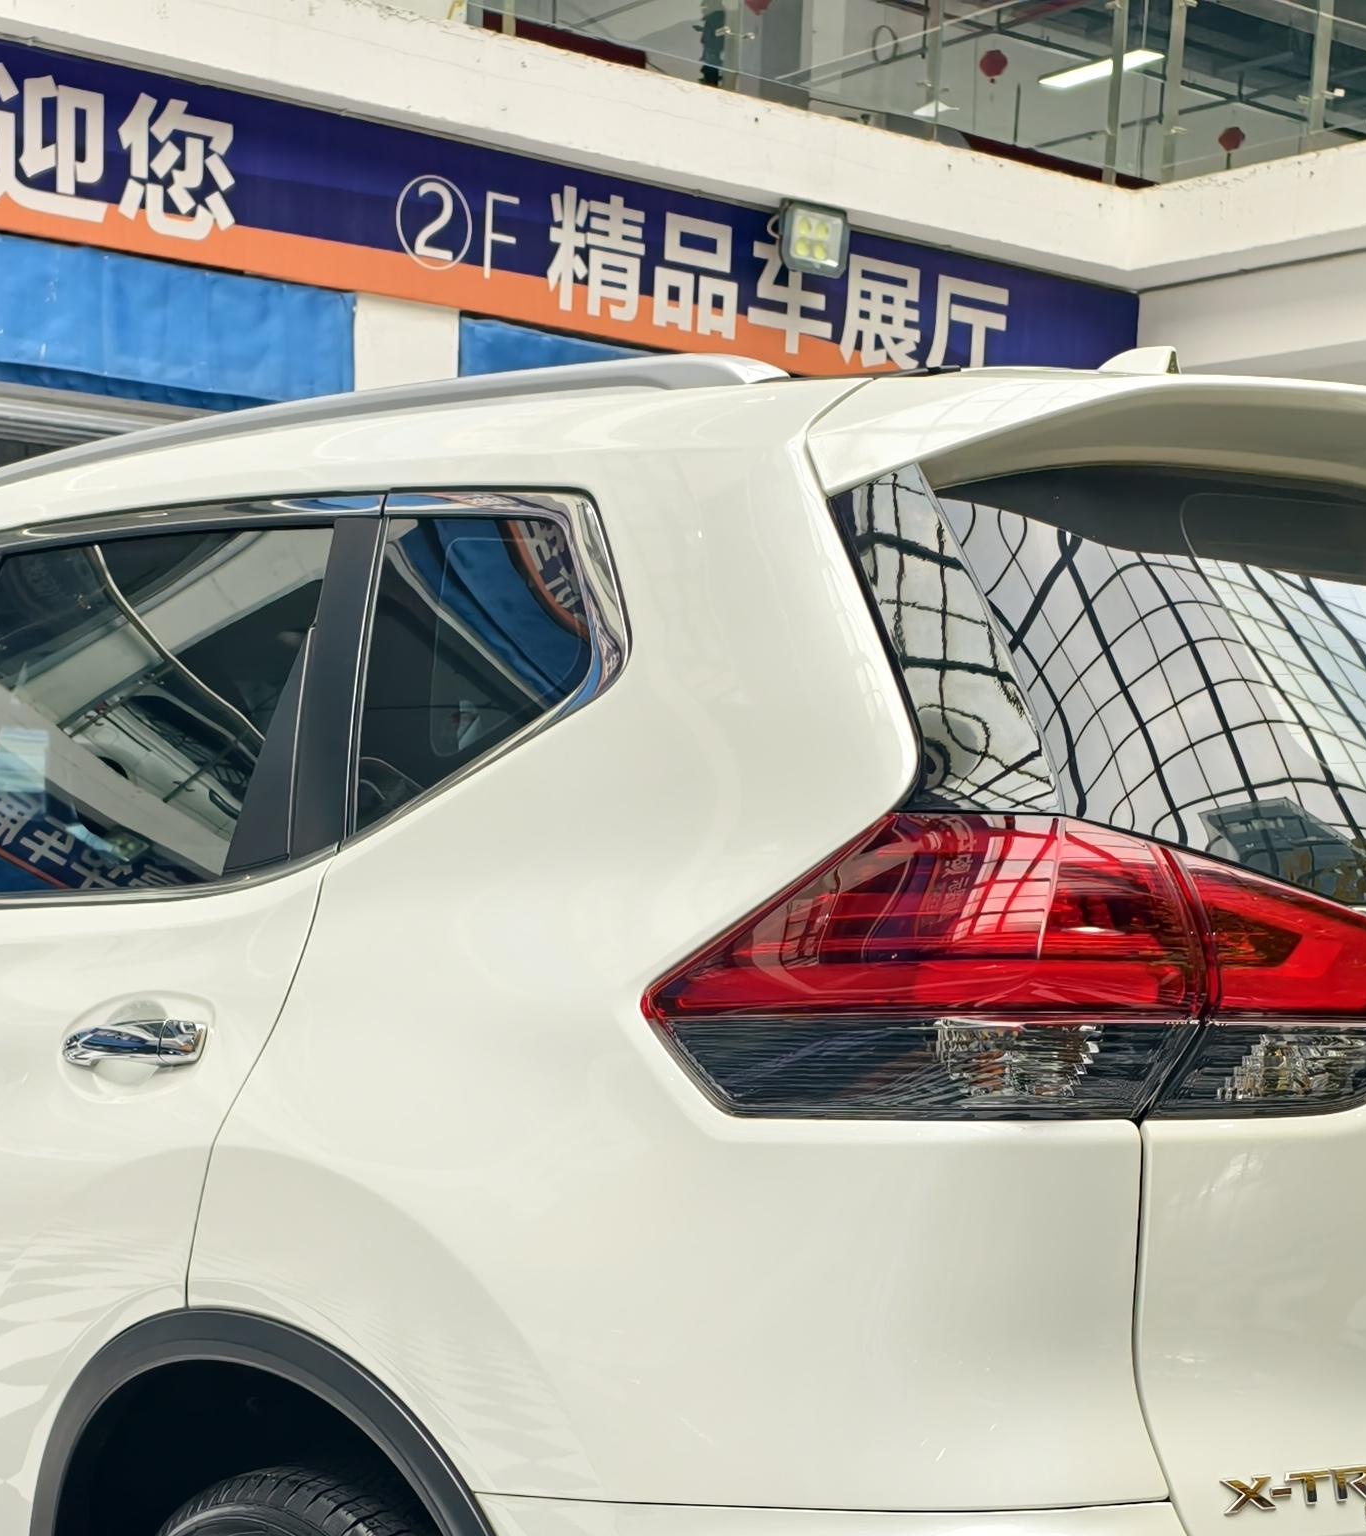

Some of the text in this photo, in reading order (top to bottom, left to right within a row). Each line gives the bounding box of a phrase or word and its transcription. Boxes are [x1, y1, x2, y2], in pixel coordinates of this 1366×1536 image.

[546, 185, 1010, 370] 精品车展厅
